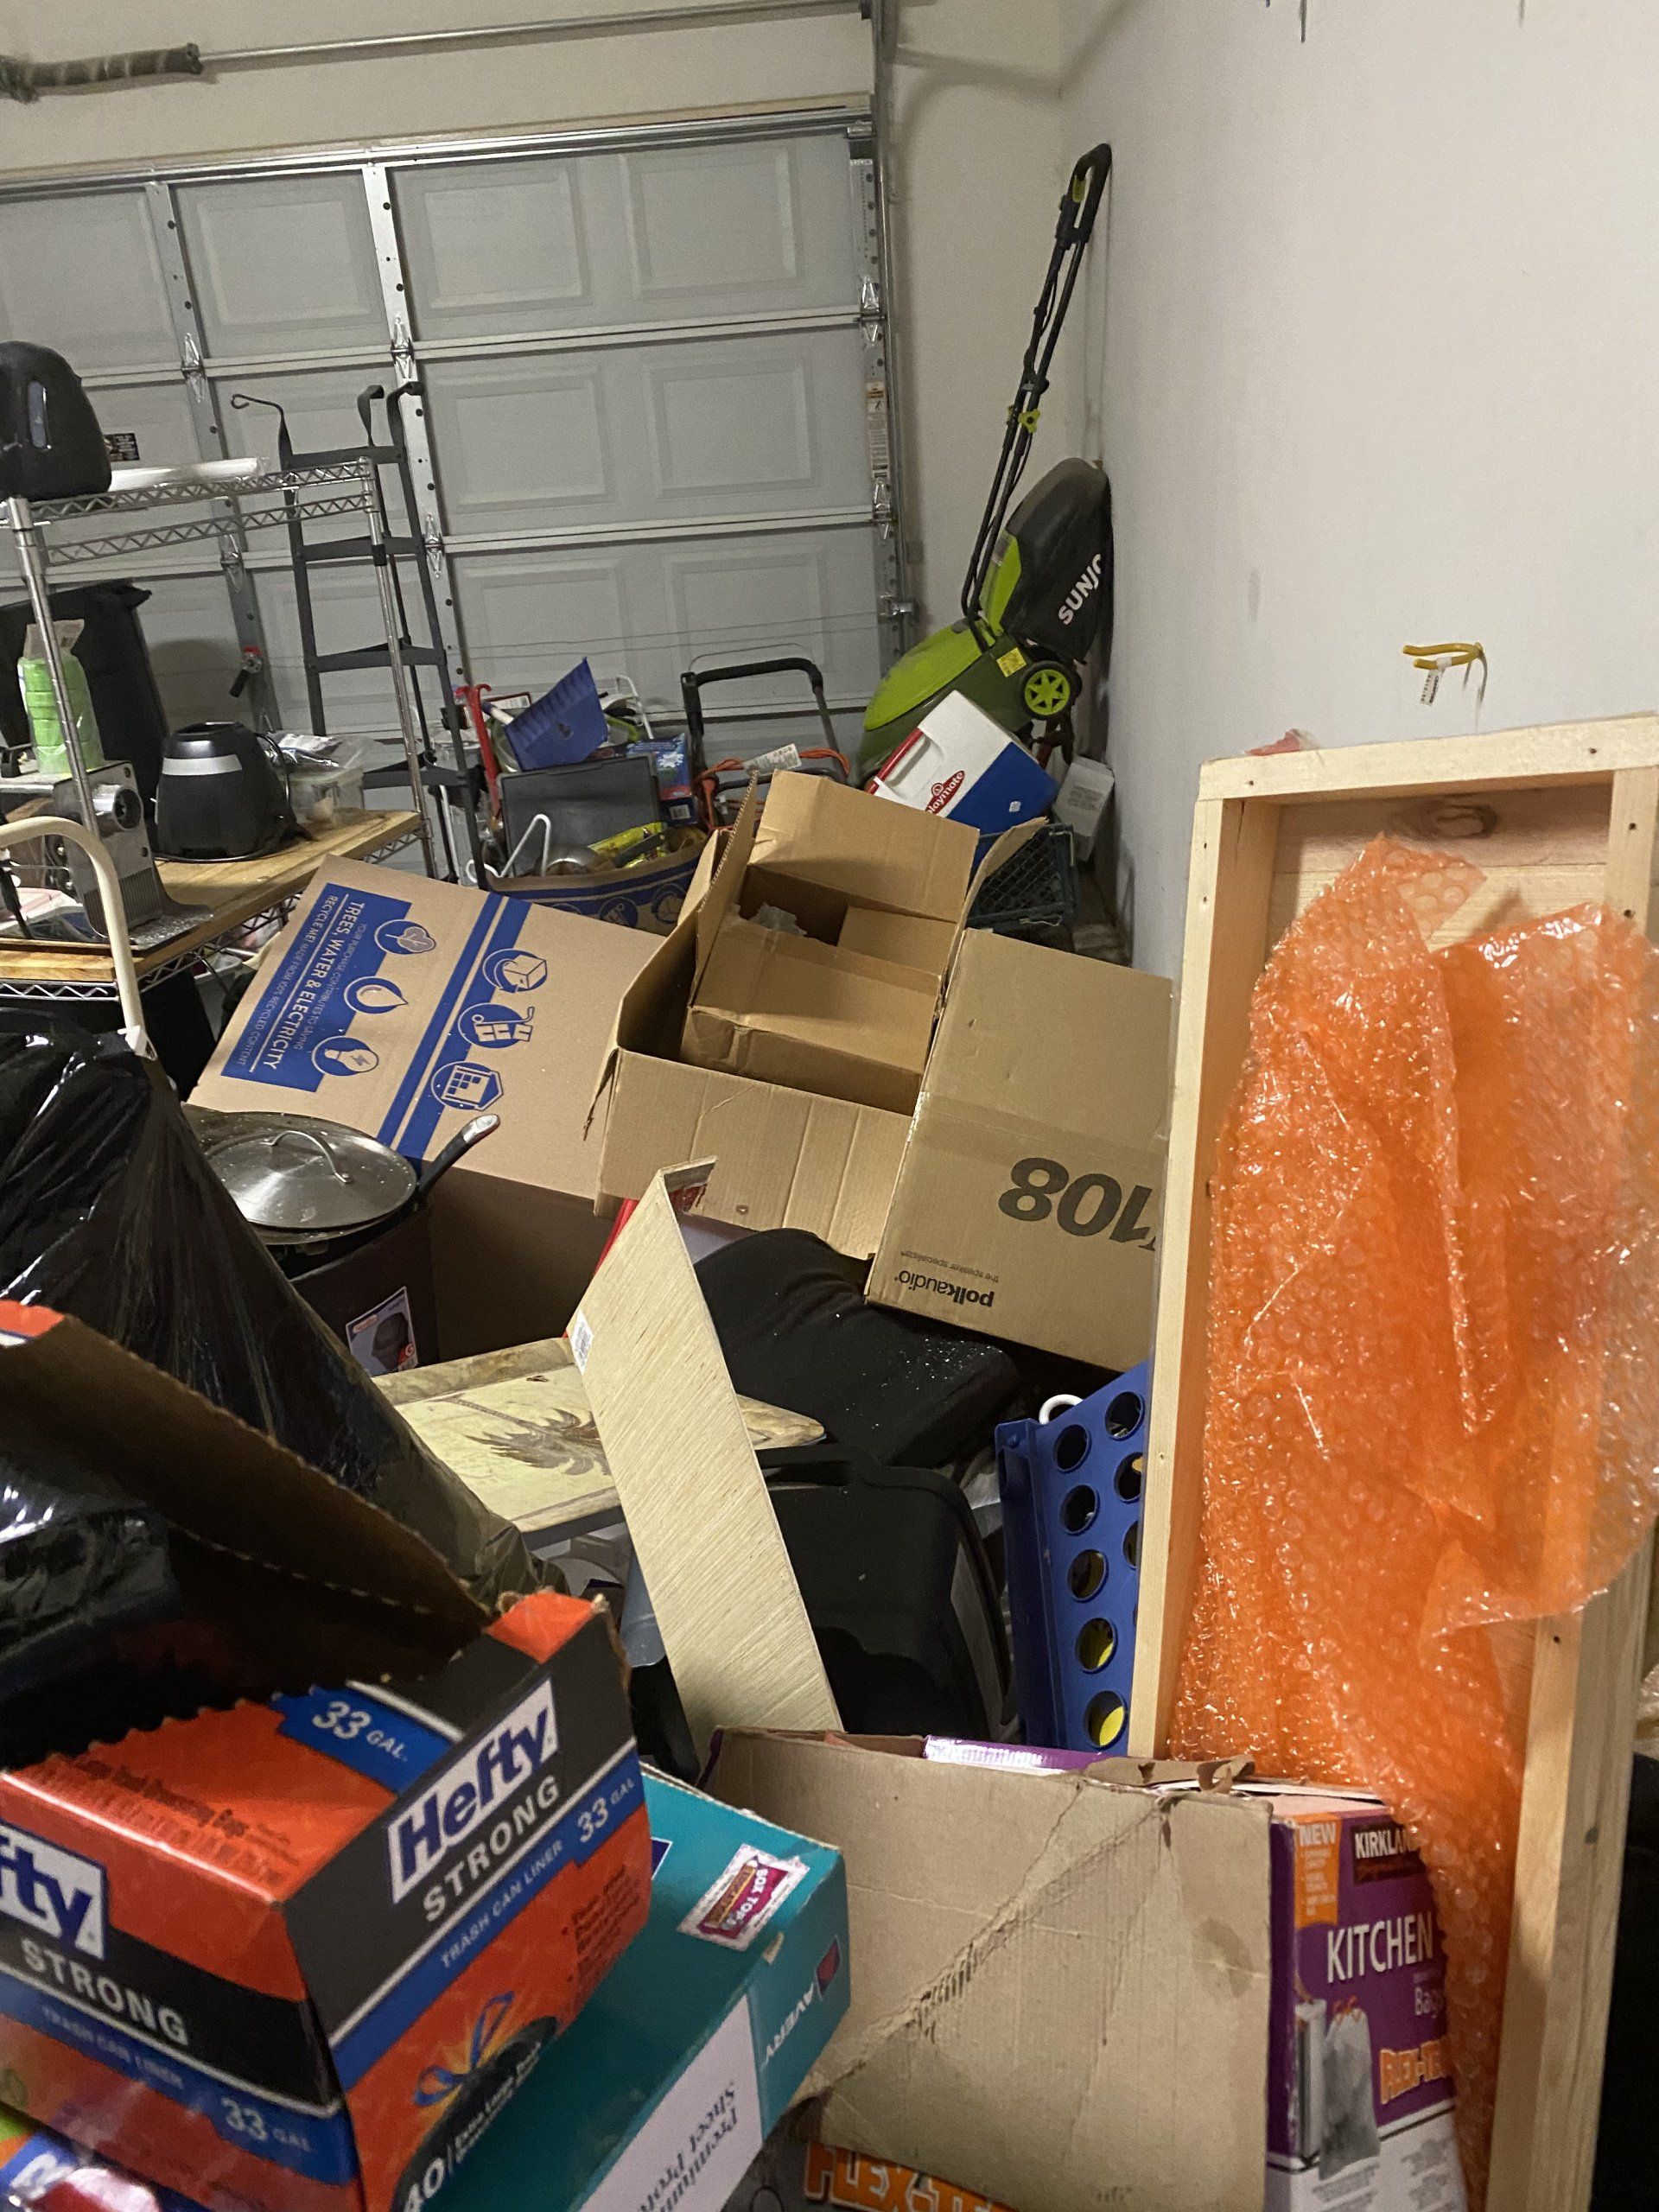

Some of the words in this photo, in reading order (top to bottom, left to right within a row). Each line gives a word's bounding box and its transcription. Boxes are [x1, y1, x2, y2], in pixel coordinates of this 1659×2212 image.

[927, 772, 963, 814] laymate
[313, 895, 337, 927] RECYCLE
[332, 900, 363, 937] TREES,
[295, 943, 308, 960] MADE
[304, 928, 319, 943] ME!
[283, 961, 298, 980] FROM
[311, 938, 343, 977] WATER
[336, 939, 358, 971] PURCHASE
[306, 979, 321, 988] &
[312, 972, 340, 1014] CONTRIBUTES
[255, 995, 279, 1029] RECYCLED
[261, 990, 315, 1069] ELECTRICITY
[308, 1015, 317, 1024] TO
[236, 1031, 261, 1065] CONTENT
[294, 1025, 313, 1050] SAVING
[998, 1157, 1156, 1251] 108
[898, 1269, 995, 1307] polkaudio
[313, 1700, 372, 1740] 33
[397, 1705, 549, 1881] Hefty
[423, 1775, 560, 1923] STRONG
[1299, 1821, 1337, 1847] NEW
[1354, 1827, 1410, 1859] KIRKLAN
[441, 1916, 490, 1968] TRASH
[492, 1882, 523, 1918] CAN
[523, 1839, 564, 1885] LINER
[576, 1796, 609, 1843] 33
[609, 1777, 635, 1805] GAL
[751, 1868, 769, 1894] BOX
[1326, 1910, 1434, 1984] KITCHEN
[21, 1937, 189, 2046] STRONG
[1414, 1987, 1445, 2020] Bag
[220, 2095, 269, 2142] 33
